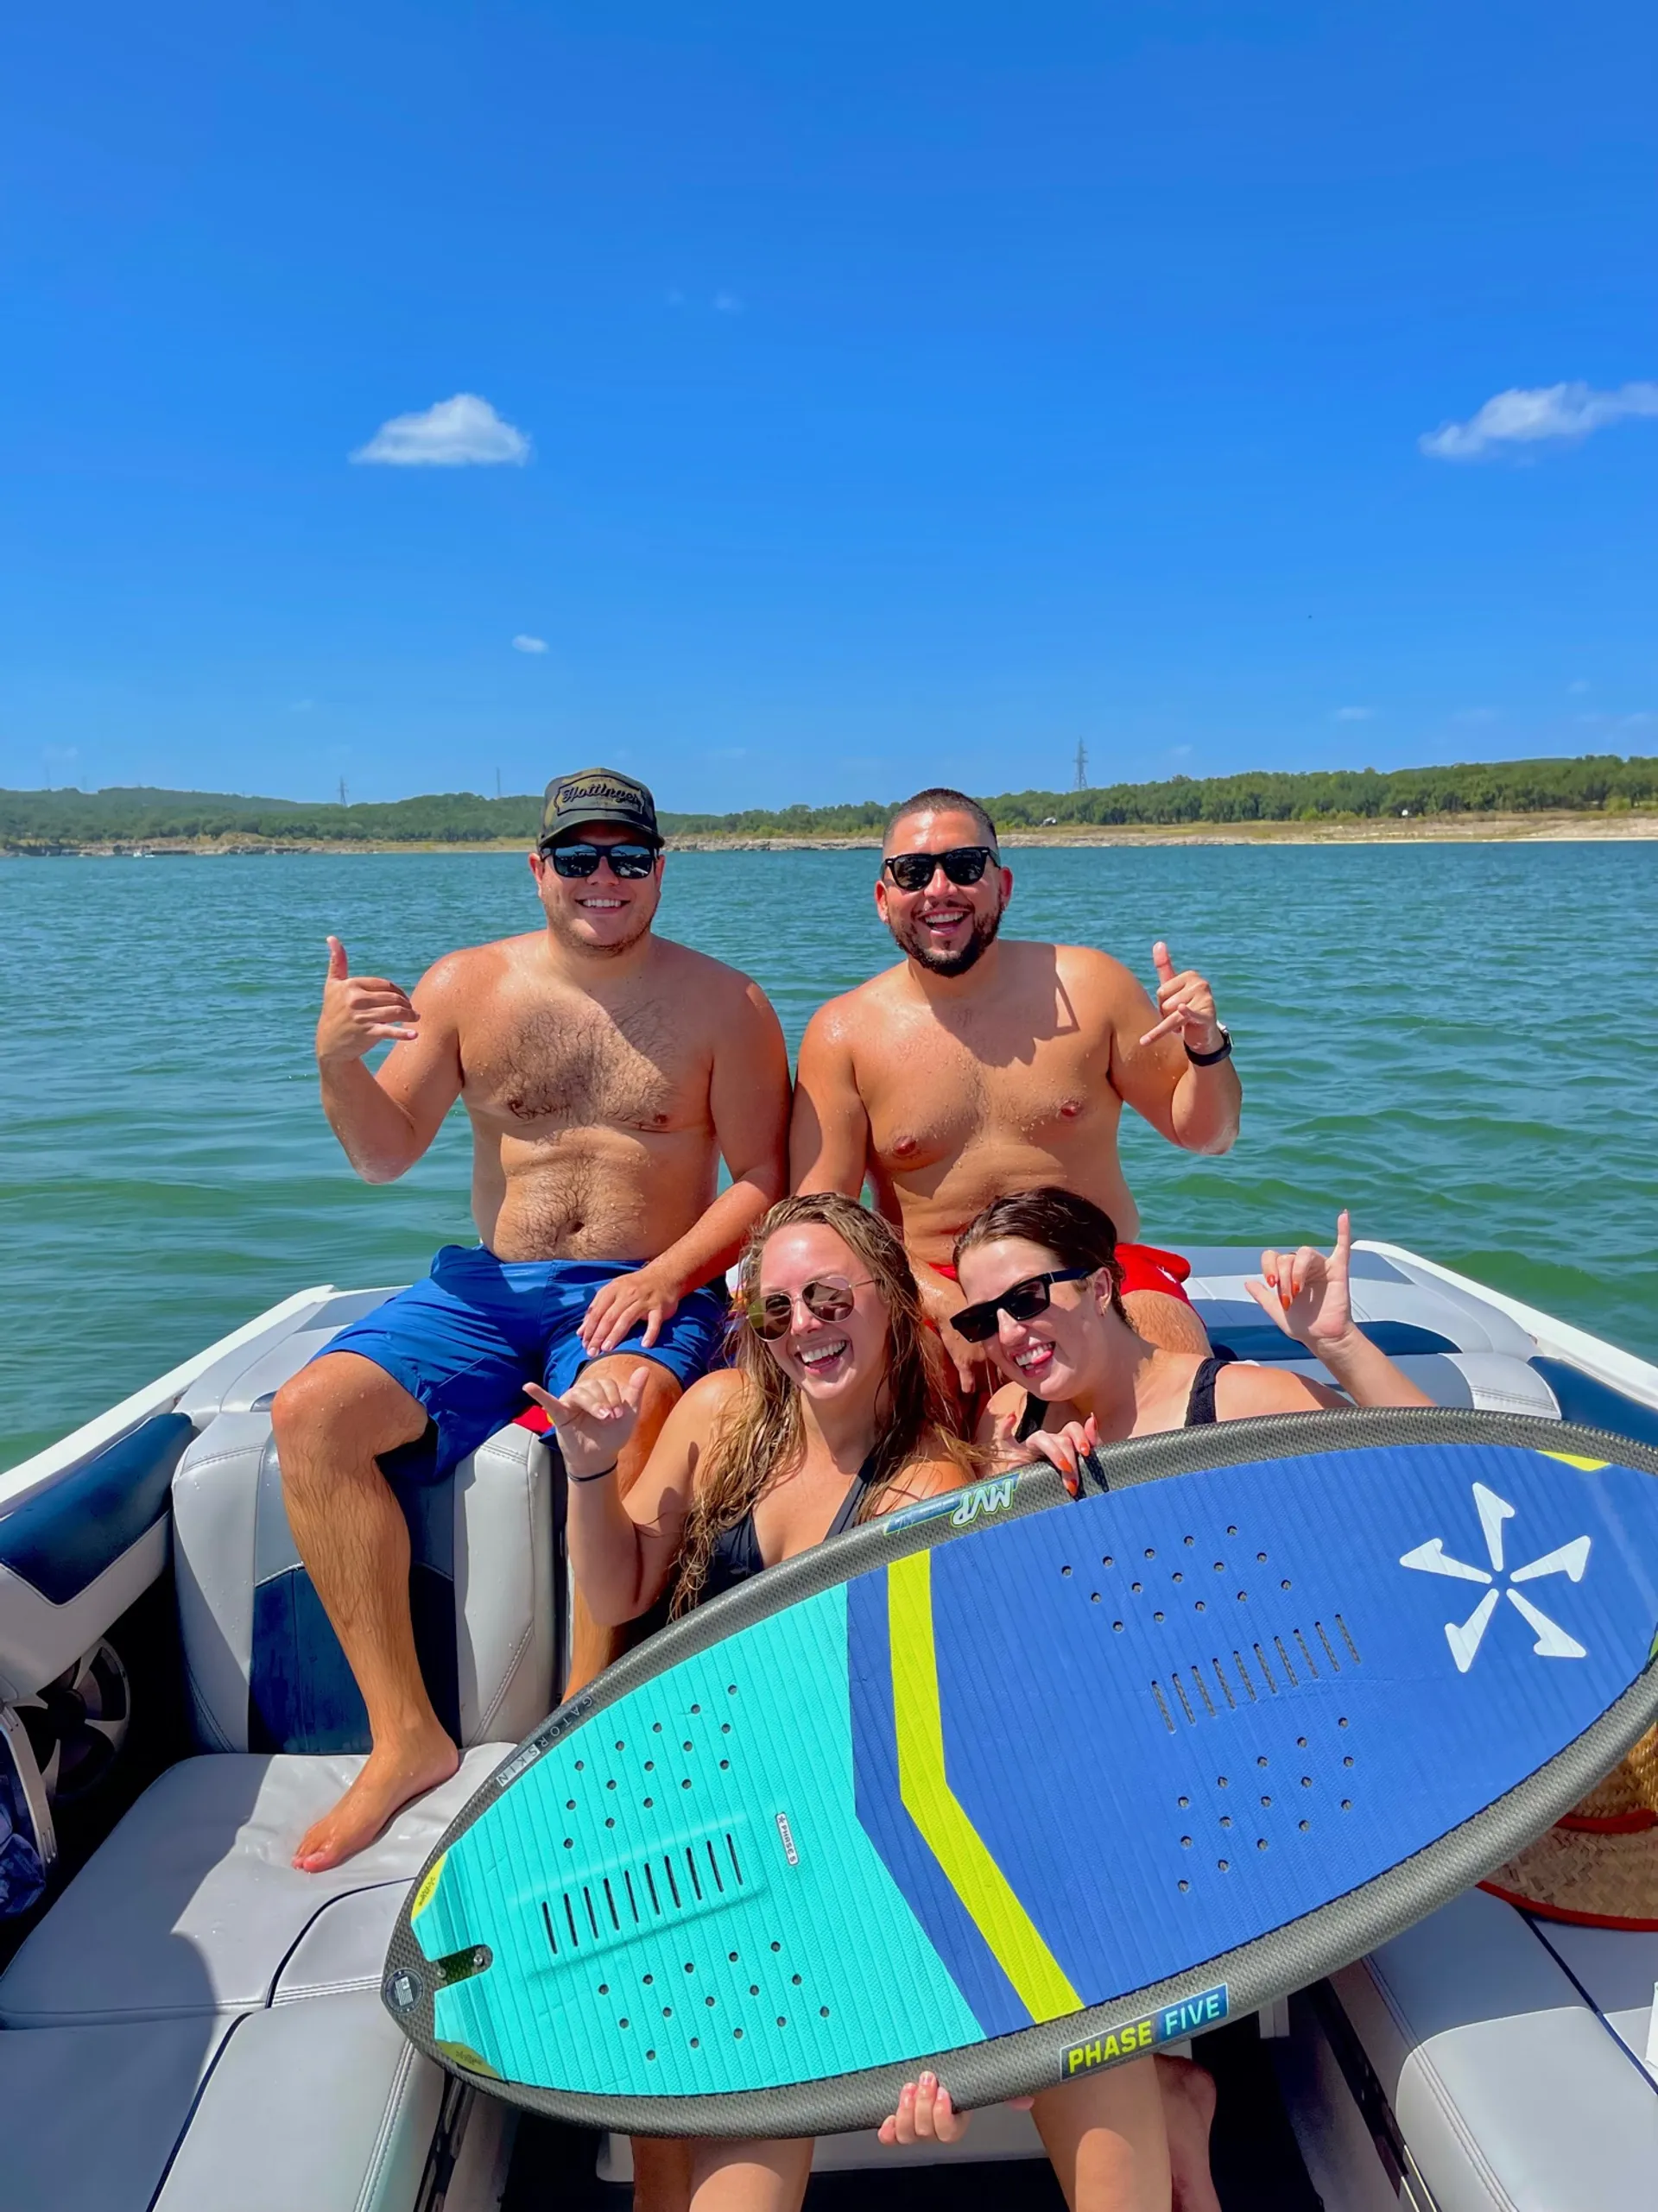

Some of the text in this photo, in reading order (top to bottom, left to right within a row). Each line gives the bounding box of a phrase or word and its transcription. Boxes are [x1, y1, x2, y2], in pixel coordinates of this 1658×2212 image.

[952, 1478, 1014, 1526] MVP
[781, 1824, 794, 1855] PHASE
[1068, 1993, 1220, 2074] PHASE FIVE
